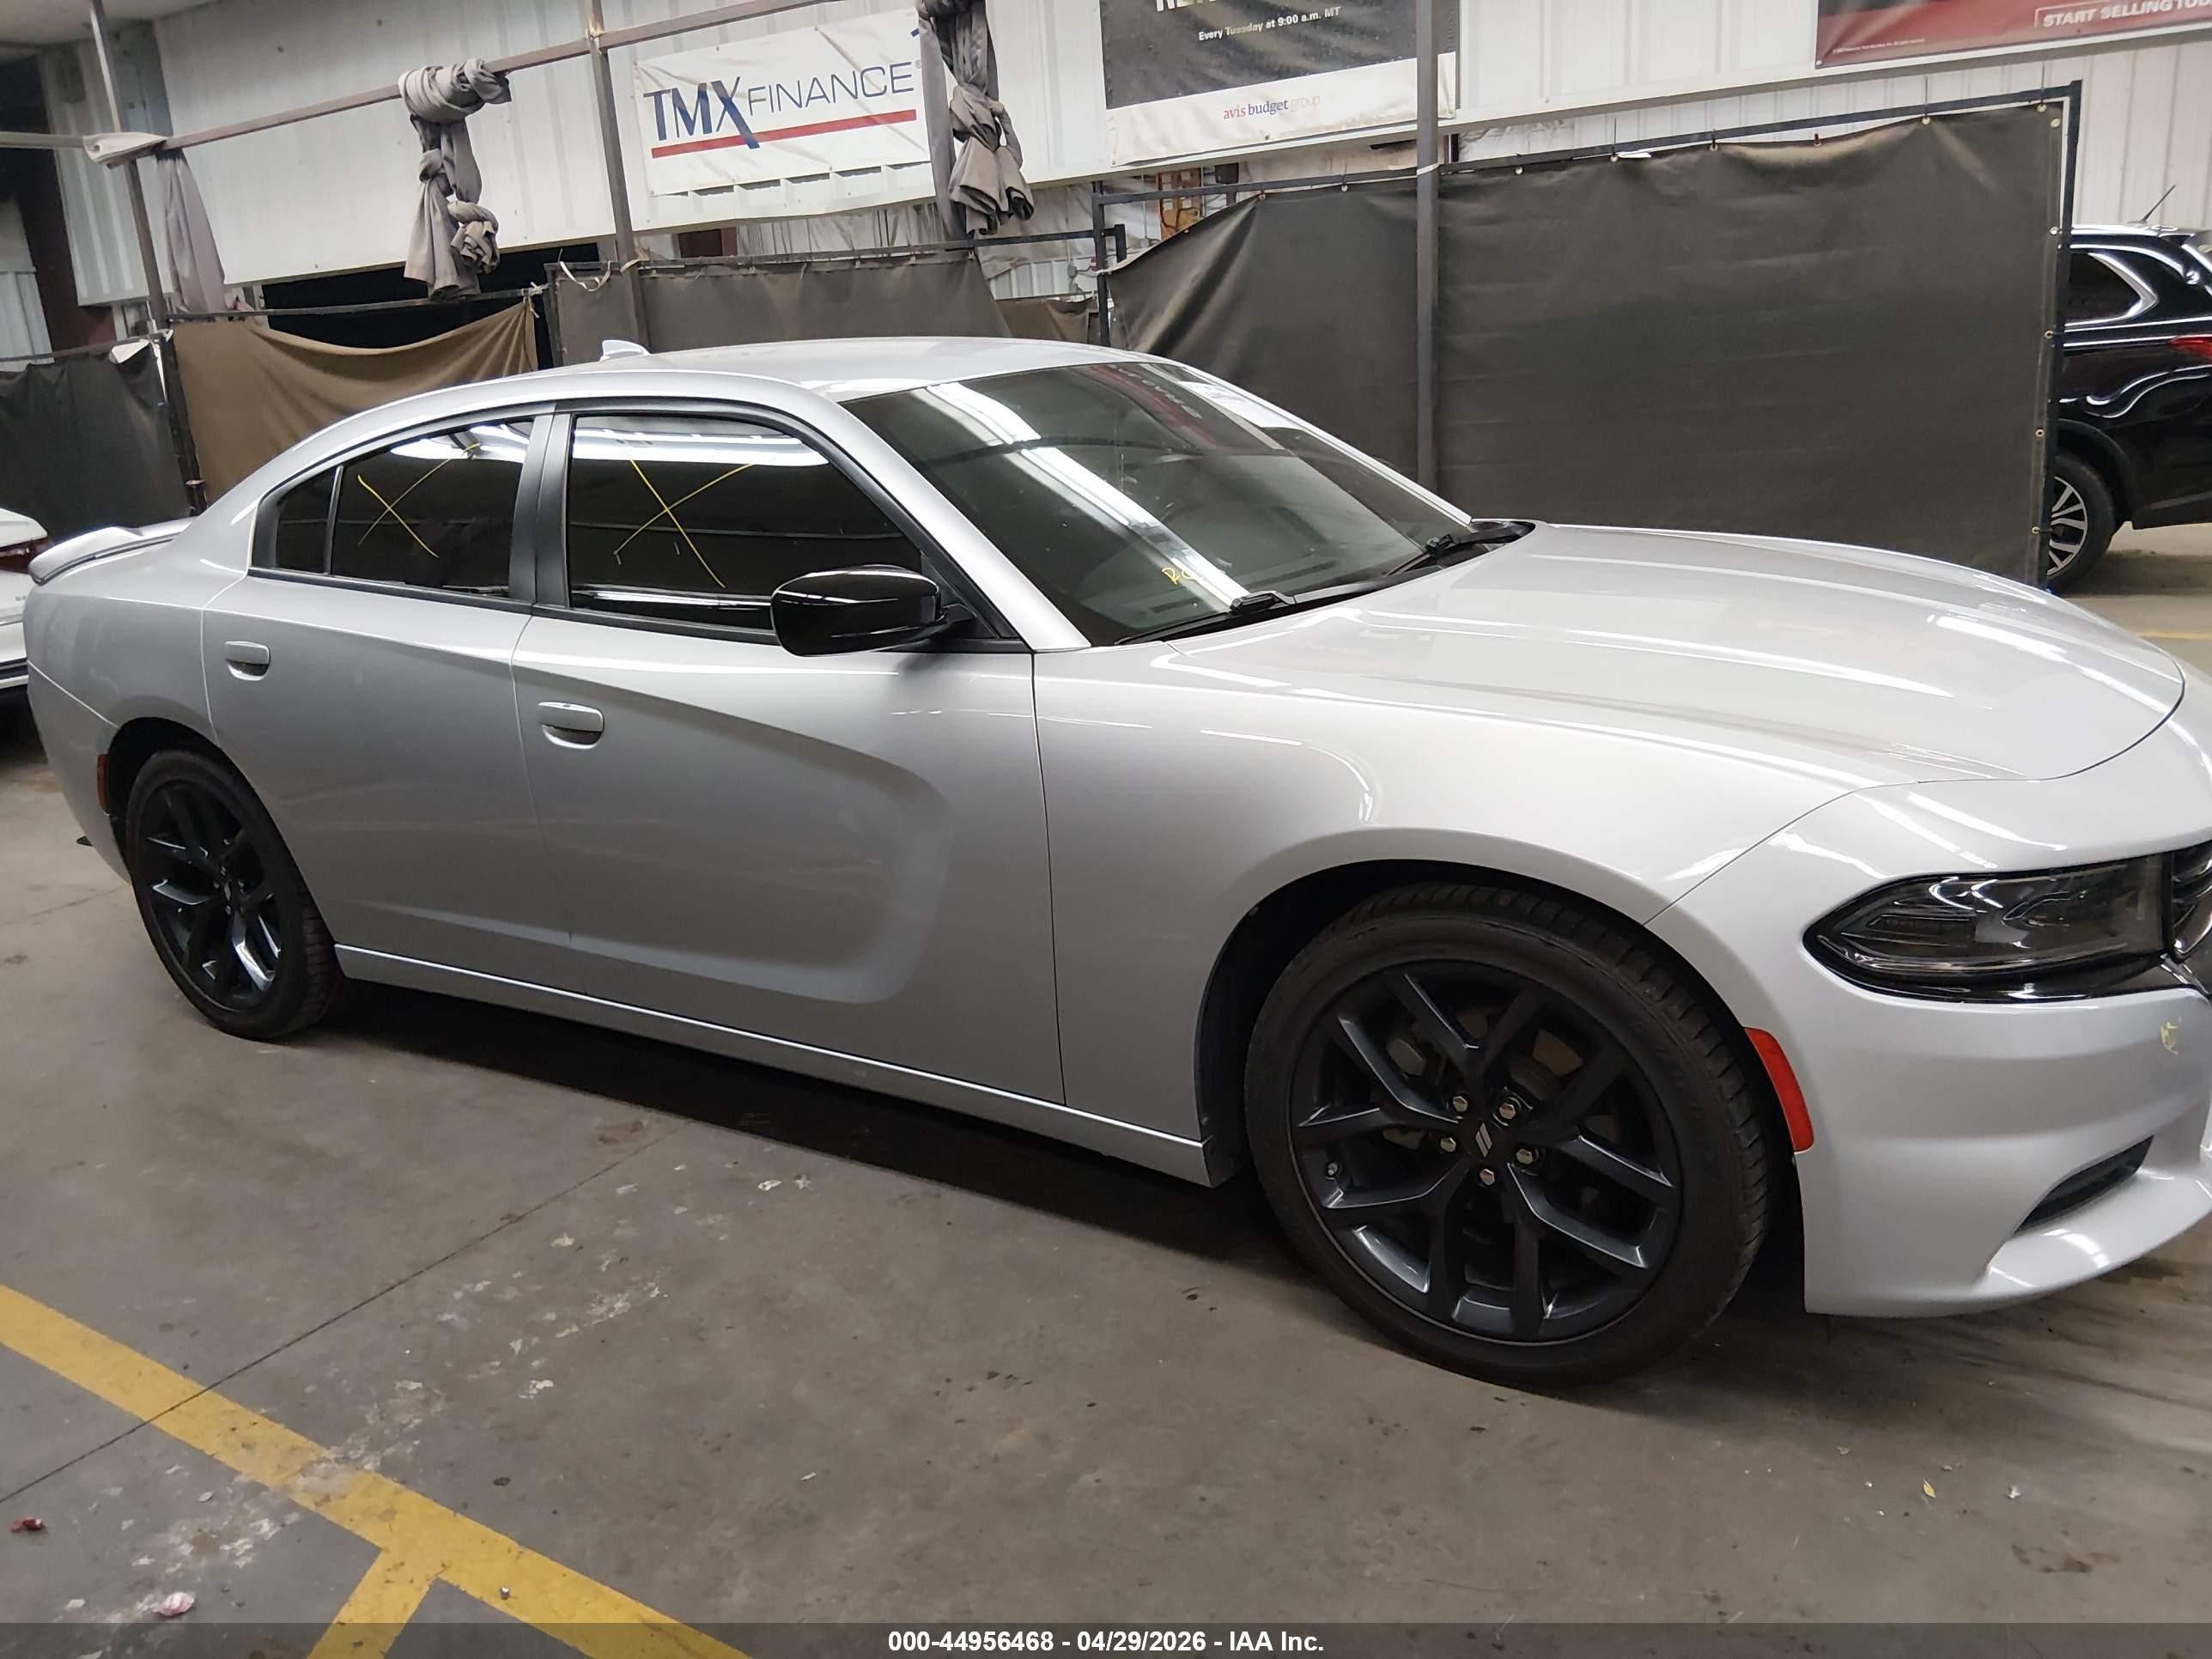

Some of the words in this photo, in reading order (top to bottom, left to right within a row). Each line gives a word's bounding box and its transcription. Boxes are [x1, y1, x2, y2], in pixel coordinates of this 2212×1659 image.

[1199, 28, 1223, 41] Every
[1225, 22, 1263, 36] Tuesday
[1266, 19, 1275, 29] at
[1278, 14, 1298, 27] 9:00
[1301, 11, 1322, 22] a.m.
[1324, 6, 1342, 18] MT
[2043, 9, 2097, 27] START
[2100, 0, 2172, 20] SELLING
[2176, 0, 2212, 9] TOD
[643, 76, 760, 149] TMX
[748, 62, 915, 116] FINANCE
[1224, 105, 1246, 119] avis
[1249, 99, 1289, 115] budget
[1291, 96, 1321, 112] group
